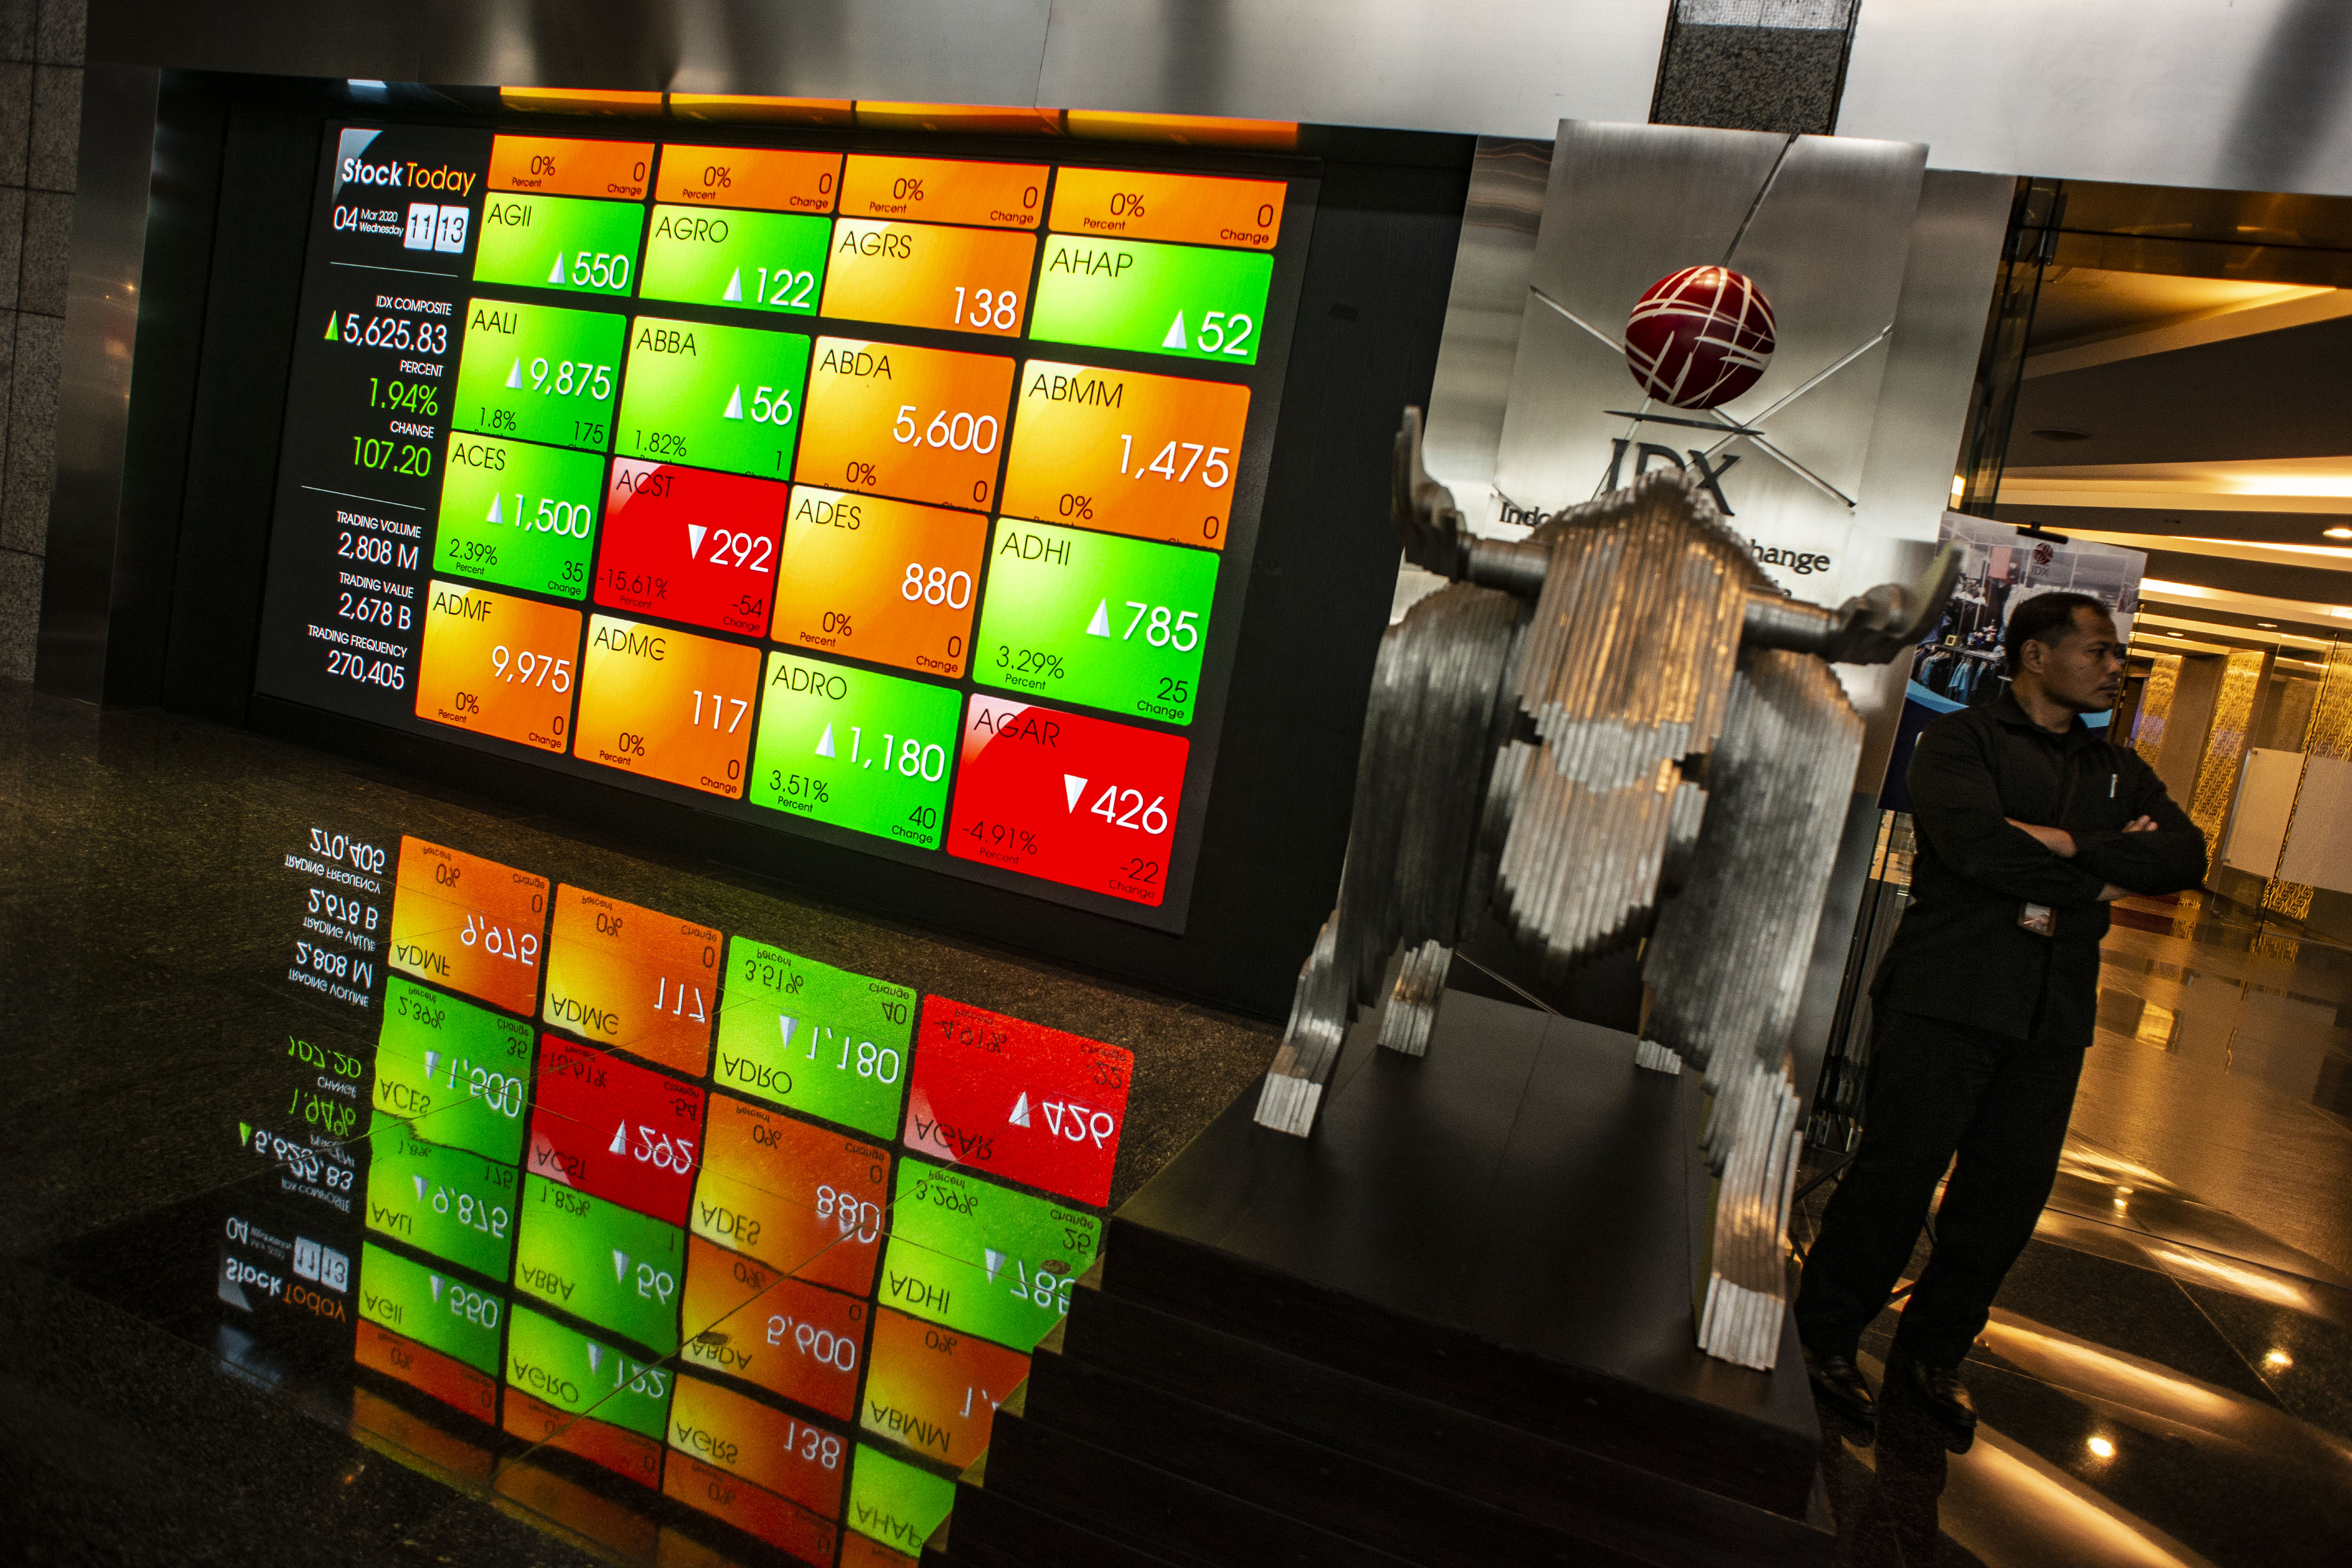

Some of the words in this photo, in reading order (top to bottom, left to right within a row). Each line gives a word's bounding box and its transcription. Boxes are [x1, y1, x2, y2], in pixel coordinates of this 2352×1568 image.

[342, 158, 402, 188] Stock
[406, 162, 476, 196] Today
[530, 155, 556, 176] 0%
[633, 162, 645, 181] 0
[704, 166, 731, 188] 0%
[512, 177, 542, 188] Percent
[607, 183, 642, 196] Change
[683, 189, 716, 200] Percent
[819, 173, 832, 194] 0
[893, 178, 924, 200] 0%
[790, 196, 828, 209] Change
[869, 202, 907, 214] Percent
[1024, 186, 1038, 209] 0
[1110, 193, 1145, 218] 0%
[333, 206, 358, 232] 04
[361, 209, 377, 221] Mar
[379, 209, 398, 223] 2020
[410, 213, 432, 242] 11
[441, 214, 464, 244] 13
[487, 205, 532, 227] AGII
[990, 210, 1034, 225] Change
[1083, 218, 1125, 230] Percent
[1257, 204, 1274, 228] 0
[359, 222, 405, 237] Wednesday
[656, 216, 729, 242] AGRO
[1220, 229, 1269, 245] Change
[839, 231, 913, 259] AGRS
[572, 252, 630, 289] 550
[1050, 248, 1133, 278] AHAP
[757, 268, 815, 308] 122
[376, 295, 393, 309] IDX
[395, 297, 452, 316] COMPOSITE
[954, 286, 1017, 330] 138
[343, 314, 447, 353] 5,625.83
[471, 310, 517, 335] AALI
[1197, 310, 1253, 356] 52
[636, 328, 697, 356] ABBA
[400, 360, 443, 377] PERCENT
[820, 349, 892, 380] ABDA
[530, 357, 612, 400] 9,875
[1028, 374, 1124, 408] ABMM
[369, 377, 438, 416] 1.94%
[750, 386, 793, 426] 56
[390, 421, 434, 439] CHANGE
[479, 407, 517, 431] 1.8%
[893, 403, 998, 454] 5,600
[575, 421, 603, 444] 175
[635, 430, 687, 457] 1.82%
[353, 436, 432, 477] 107.20
[452, 443, 506, 471] ACES
[776, 451, 782, 472] 1
[1120, 434, 1230, 488] 1,475
[616, 469, 675, 497] ACST
[846, 462, 877, 486] 0%
[973, 480, 987, 503] 0
[514, 494, 592, 539] 1,500
[795, 499, 861, 530] ADES
[1059, 493, 1093, 520] 0%
[336, 510, 379, 530] TRADING
[381, 519, 421, 538] VOLUME
[1203, 516, 1219, 540] 0
[338, 532, 392, 566] 2,808
[397, 544, 419, 570] M
[449, 539, 497, 566] 2.39%
[710, 529, 773, 573] 292
[1000, 532, 1071, 566] ADHI
[1750, 539, 1830, 575] hange
[456, 563, 485, 576] Percent
[562, 561, 583, 581] 35
[339, 572, 382, 591] TRADING
[383, 580, 413, 599] VALUE
[548, 581, 581, 595] Change
[598, 569, 669, 600] -15.61%
[901, 563, 973, 610] 880
[339, 593, 392, 626] 2,678
[399, 606, 411, 630] B
[433, 591, 492, 621] ADMF
[620, 595, 652, 610] Percent
[732, 595, 763, 617] -54
[723, 616, 760, 632] Change
[822, 611, 852, 637] 0%
[1122, 601, 1199, 653] 785
[308, 624, 349, 644] TRADING
[351, 635, 407, 658] FREQUENCY
[594, 626, 666, 660] ADMG
[800, 631, 836, 647] Percent
[947, 636, 962, 658] 0
[328, 650, 405, 690] 270,405
[492, 645, 570, 693] 9,975
[916, 655, 958, 673] Change
[995, 646, 1065, 680] 3.29%
[771, 665, 847, 700] ADRO
[1005, 674, 1047, 691] Percent
[1157, 677, 1188, 704] 25
[438, 708, 467, 723] Percent
[456, 692, 479, 714] 0%
[693, 690, 748, 734] 117
[1137, 701, 1185, 720] Change
[553, 716, 564, 735] 0
[973, 708, 1060, 748] AGAR
[529, 733, 562, 748] Change
[619, 732, 645, 756] 0%
[600, 750, 631, 767] Percent
[850, 726, 946, 782] 1,180
[727, 759, 740, 780] 0
[701, 776, 737, 794] Change
[770, 770, 829, 803] 3.51%
[778, 796, 813, 813] Percent
[1091, 785, 1168, 835] 426
[908, 806, 937, 830] 40
[891, 825, 933, 844] Change
[963, 821, 1038, 855] -4.91%
[980, 847, 1020, 865] Percent
[1120, 857, 1159, 884] -22
[1108, 879, 1155, 900] Change
